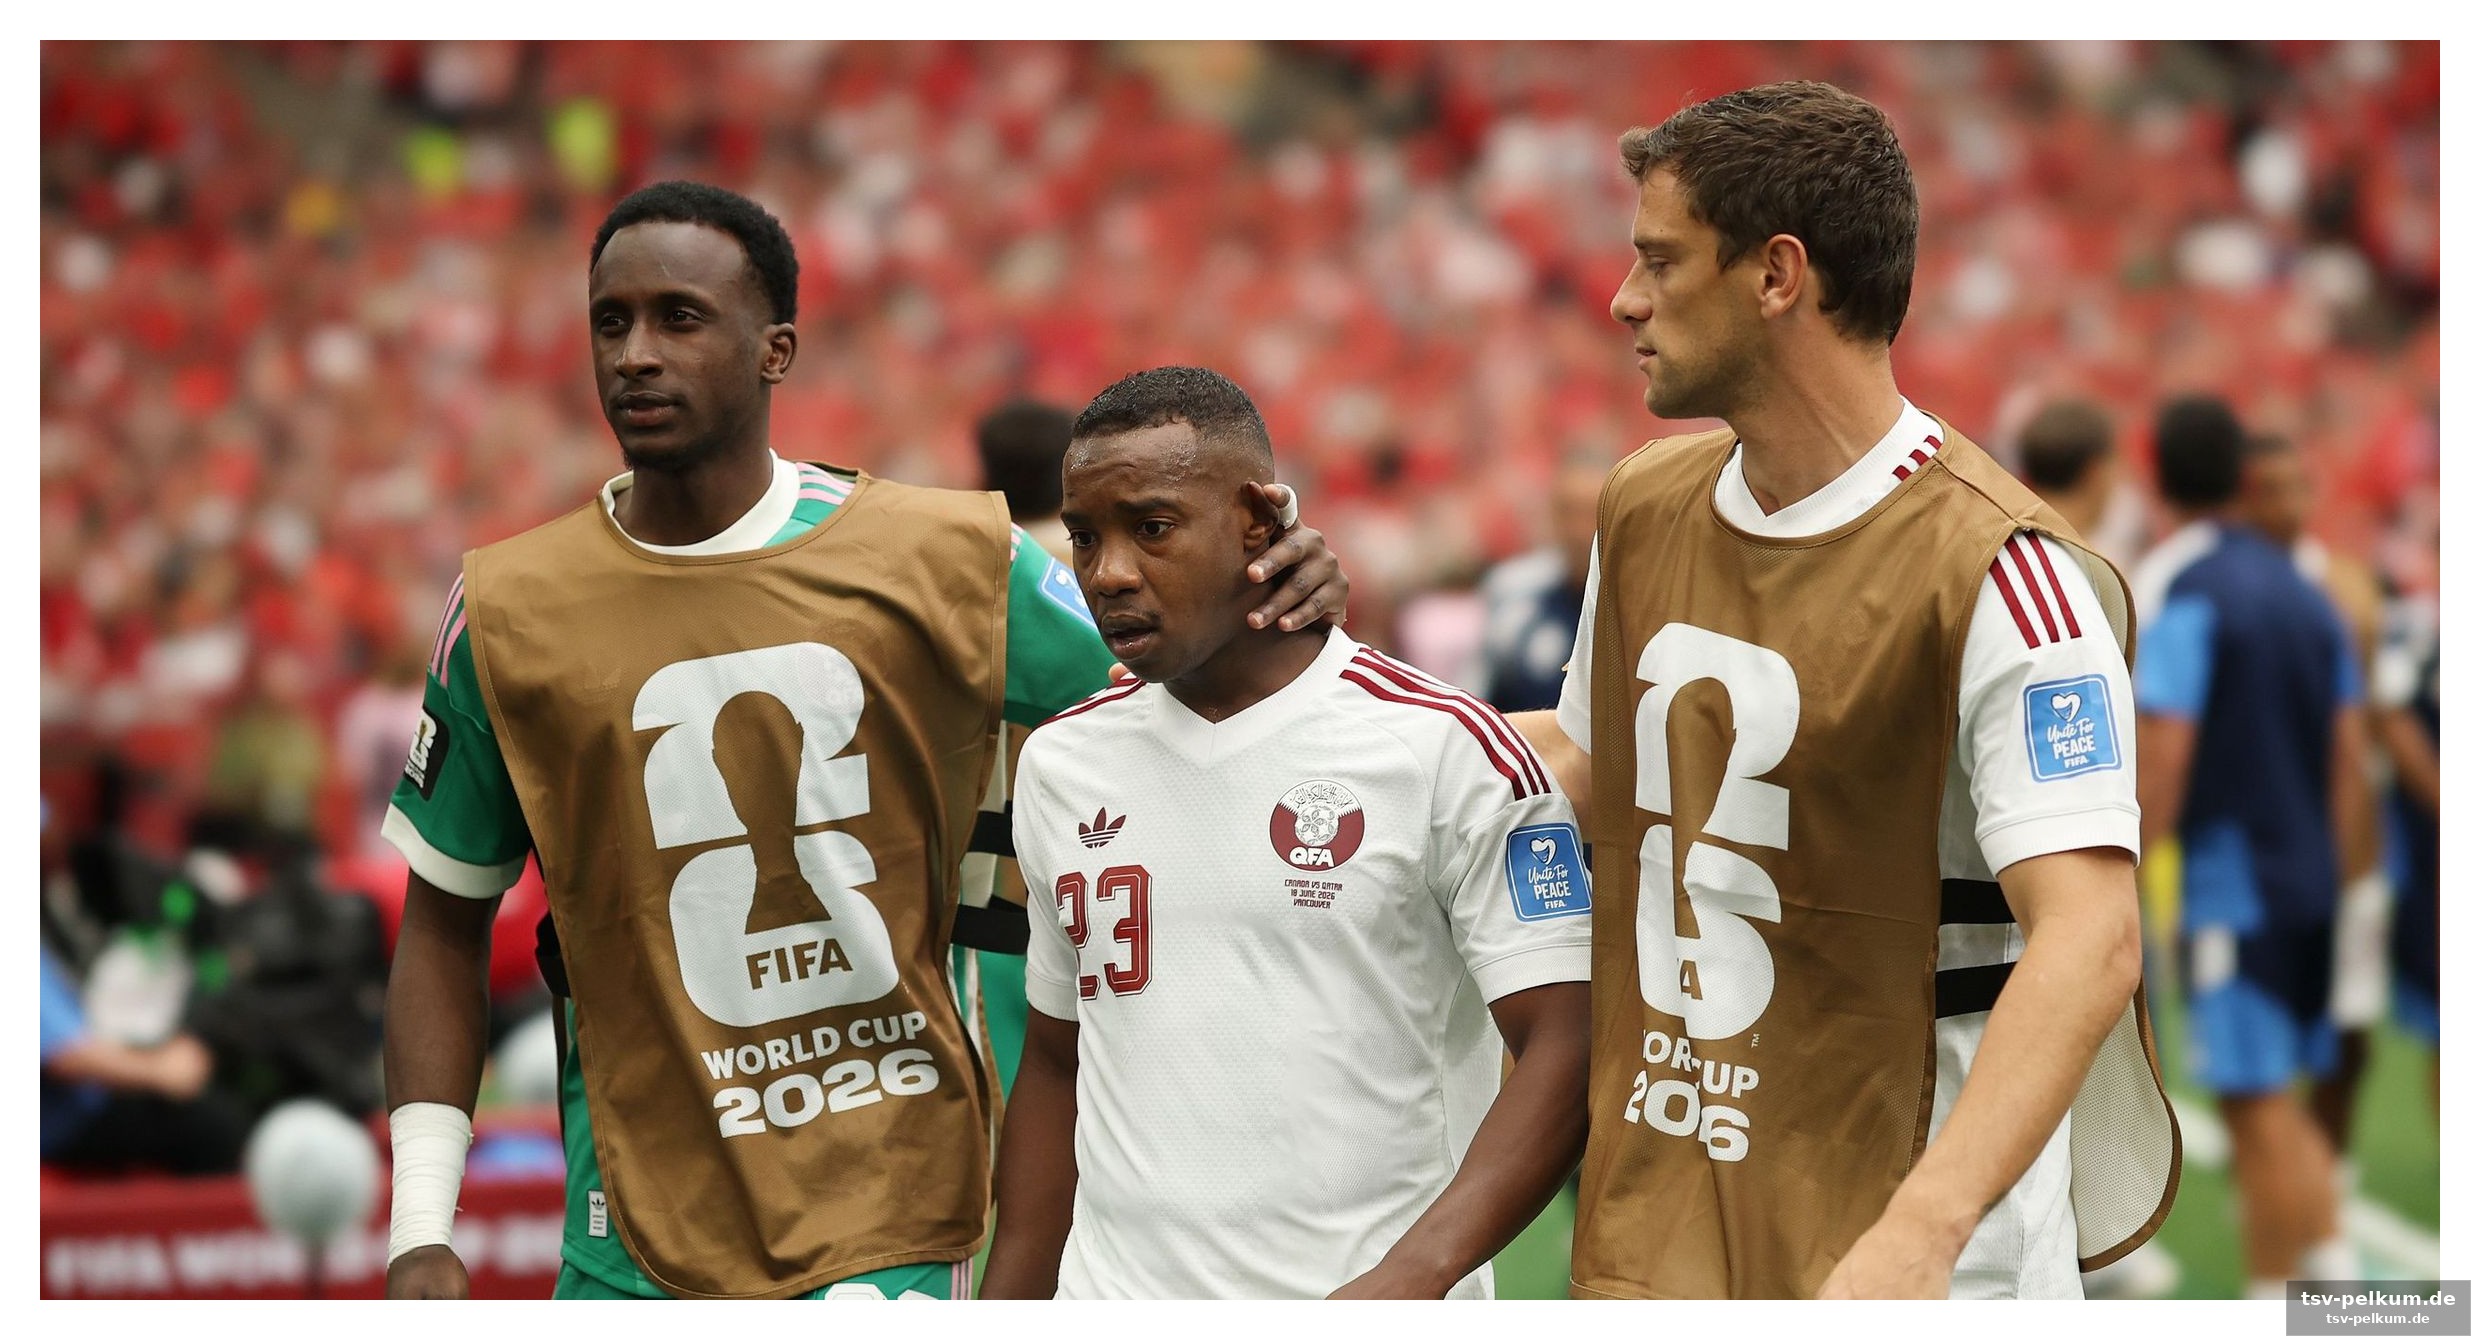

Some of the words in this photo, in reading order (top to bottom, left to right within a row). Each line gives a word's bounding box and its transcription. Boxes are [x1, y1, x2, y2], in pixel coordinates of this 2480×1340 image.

[2047, 721, 2077, 744] Unite
[2077, 717, 2095, 736] For
[2053, 735, 2096, 760] PEACE
[2064, 755, 2088, 768] FIFA
[1289, 846, 1335, 868] QFA
[1284, 879, 1309, 888] CANADA
[1311, 880, 1320, 889] VS
[1321, 882, 1343, 891] QATAR
[1528, 866, 1555, 885] Unite
[1554, 863, 1569, 880] For
[1290, 888, 1297, 897] 18
[1300, 890, 1316, 898] JUNE
[1318, 890, 1335, 900] 2026
[1533, 880, 1572, 900] PEACE
[1293, 898, 1331, 910] VANCOUVER
[1544, 899, 1566, 909] FIFA
[1055, 864, 1153, 1001] 23
[745, 938, 853, 990] FIFA
[701, 1026, 841, 1081] WORLD
[848, 1009, 928, 1045] CUP
[1690, 1057, 1760, 1099] UP
[713, 1048, 940, 1139] 2026
[1623, 1070, 1751, 1162] 206
